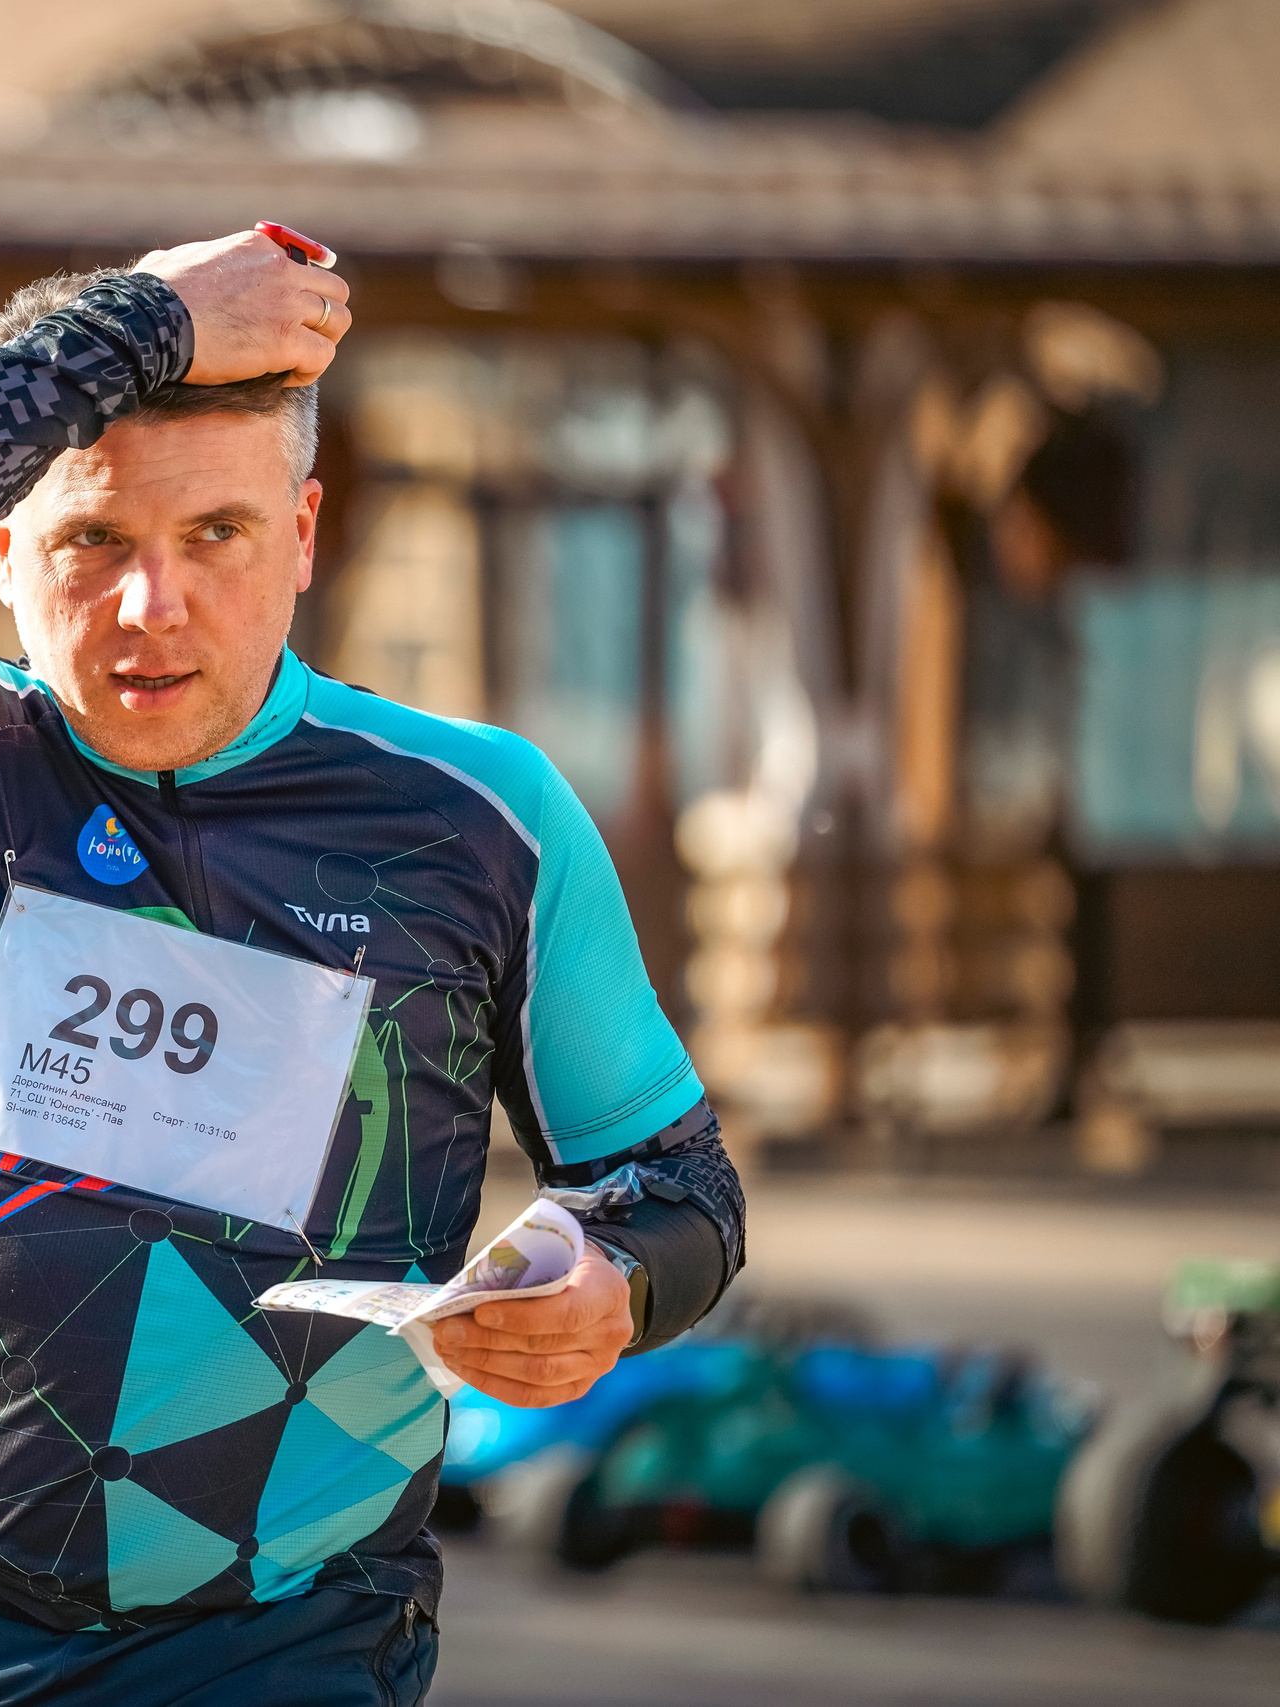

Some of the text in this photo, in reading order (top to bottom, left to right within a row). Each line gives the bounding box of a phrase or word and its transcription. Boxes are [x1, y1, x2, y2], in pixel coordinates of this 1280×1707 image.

[48, 974, 219, 1075] 299
[12, 1074, 127, 1113] Дорогинин Александр
[5, 1101, 88, 1131] SI-чип: 8136452
[102, 1112, 124, 1126] Пав
[152, 1111, 185, 1127] Старт
[193, 1122, 237, 1141] 10:31:00
